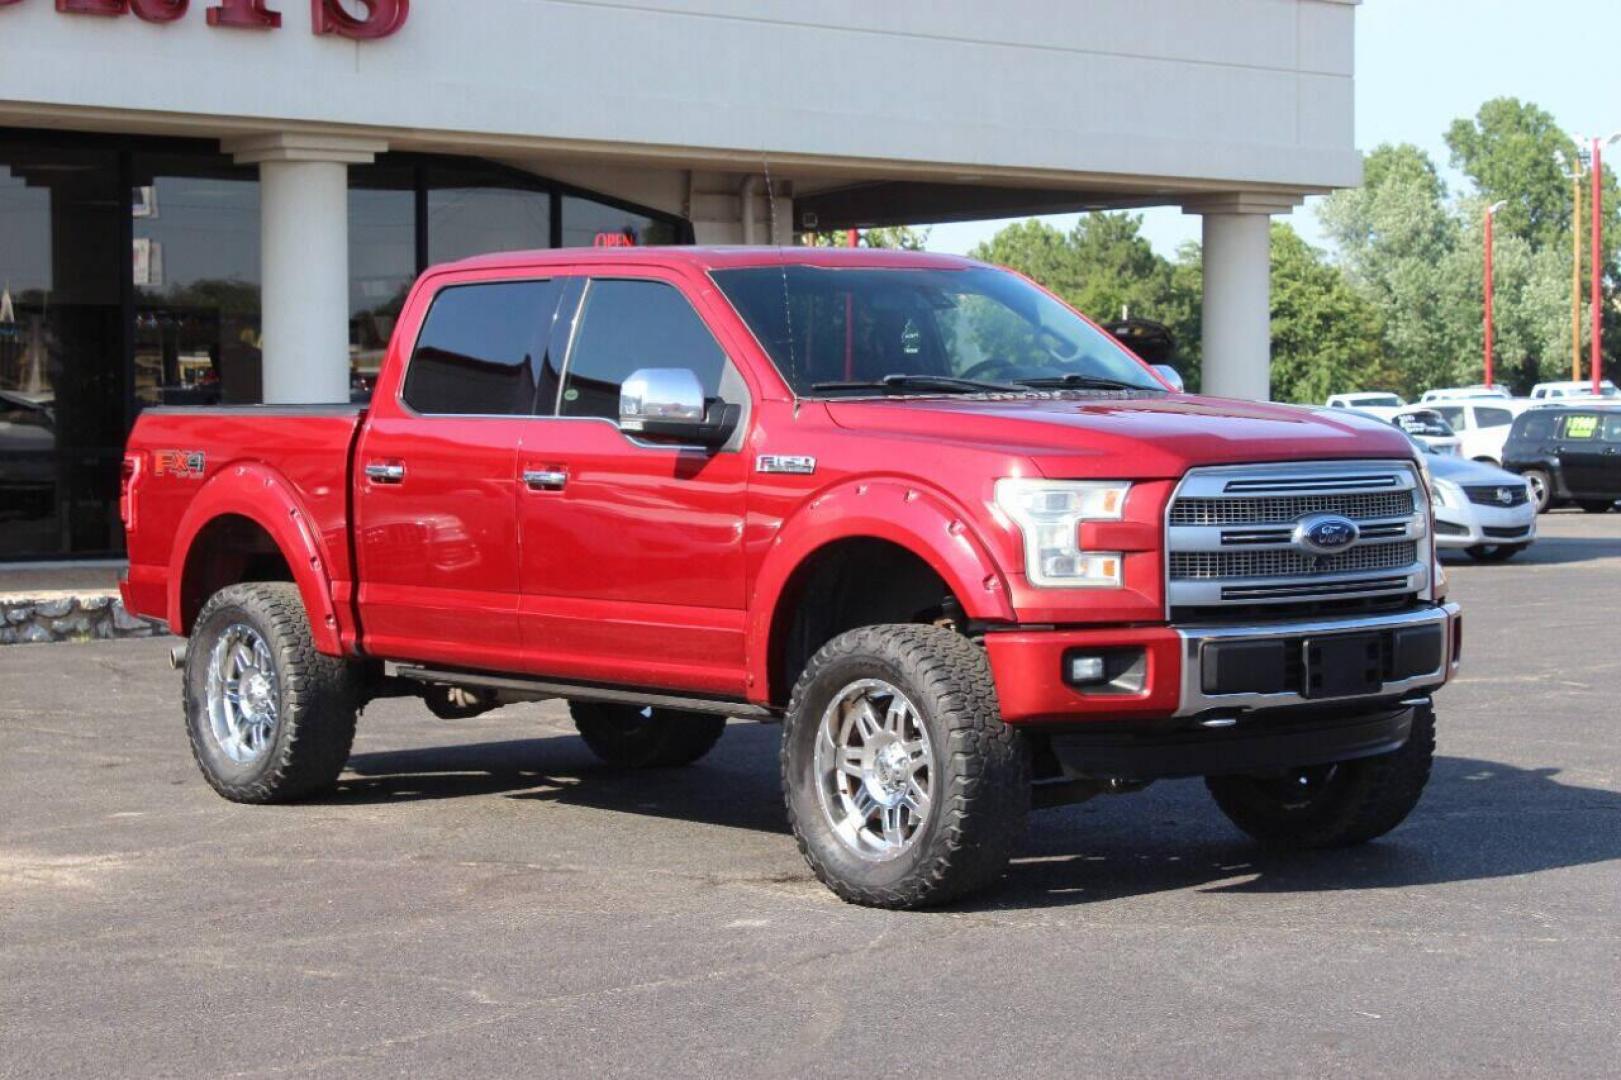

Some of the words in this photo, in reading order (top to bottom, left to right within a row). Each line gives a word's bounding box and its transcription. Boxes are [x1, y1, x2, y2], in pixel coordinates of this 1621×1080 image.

[593, 231, 633, 248] OPEN
[154, 450, 205, 476] FX4
[1319, 525, 1349, 544] Ford
